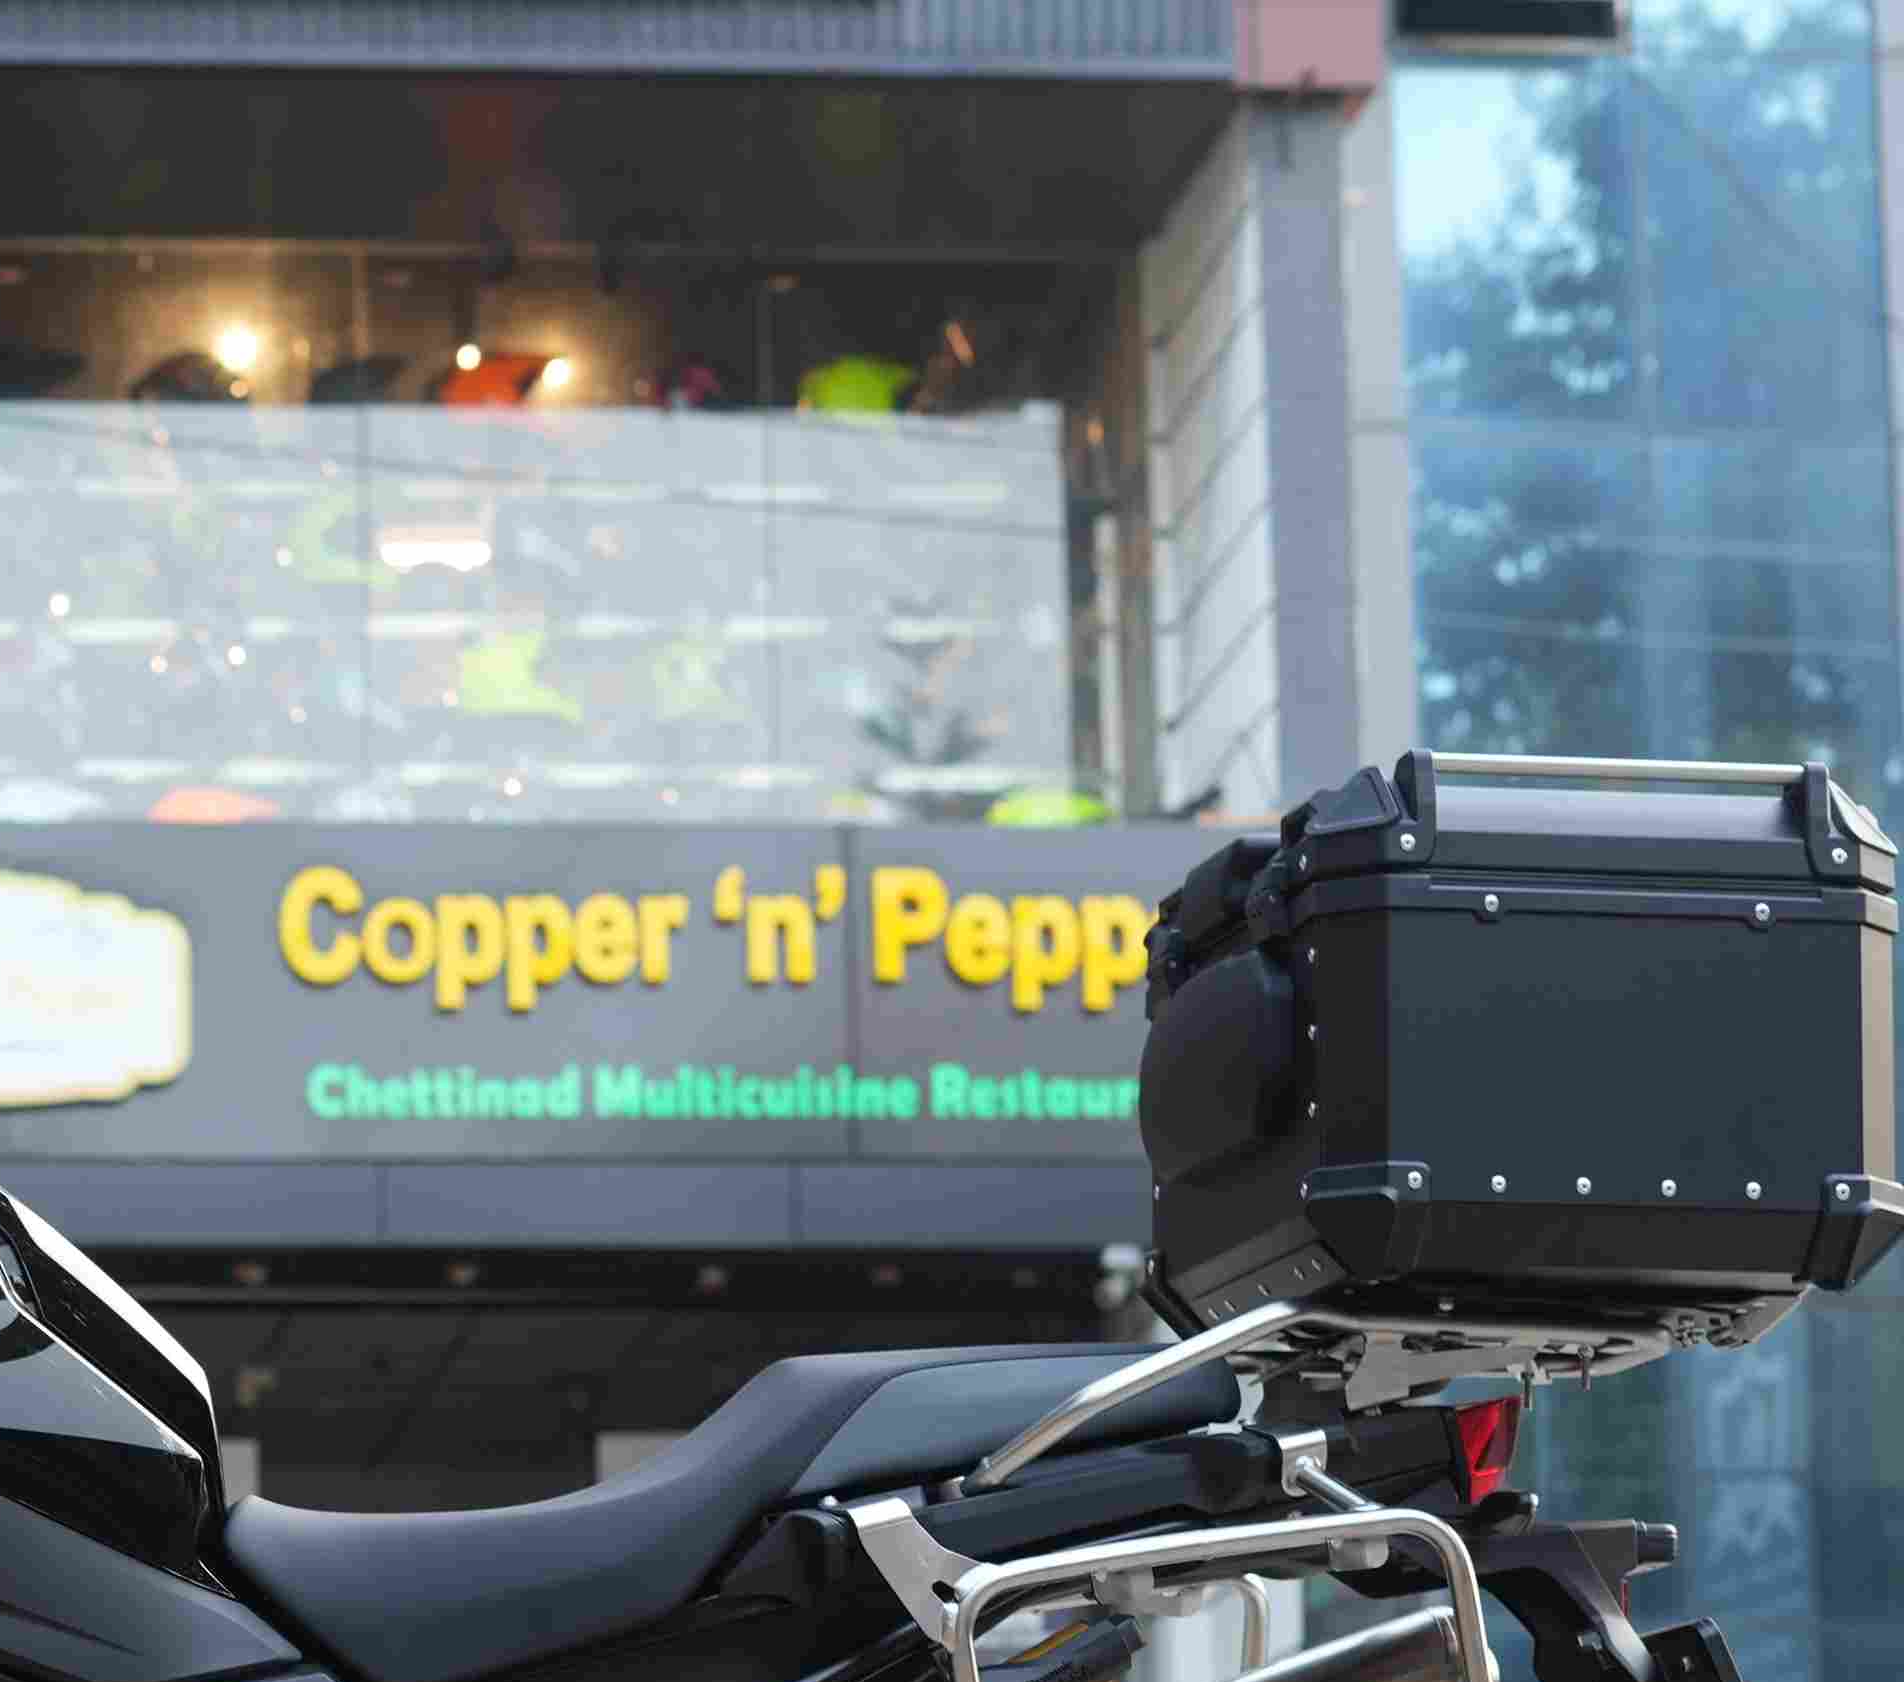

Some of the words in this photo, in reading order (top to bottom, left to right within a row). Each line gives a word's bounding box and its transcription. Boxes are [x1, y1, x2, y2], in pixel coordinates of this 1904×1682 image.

[278, 866, 690, 1013] Copper
[870, 867, 1158, 1013] Pepp
[306, 1062, 583, 1120] Chettinad
[594, 1062, 920, 1120] Multicuisine
